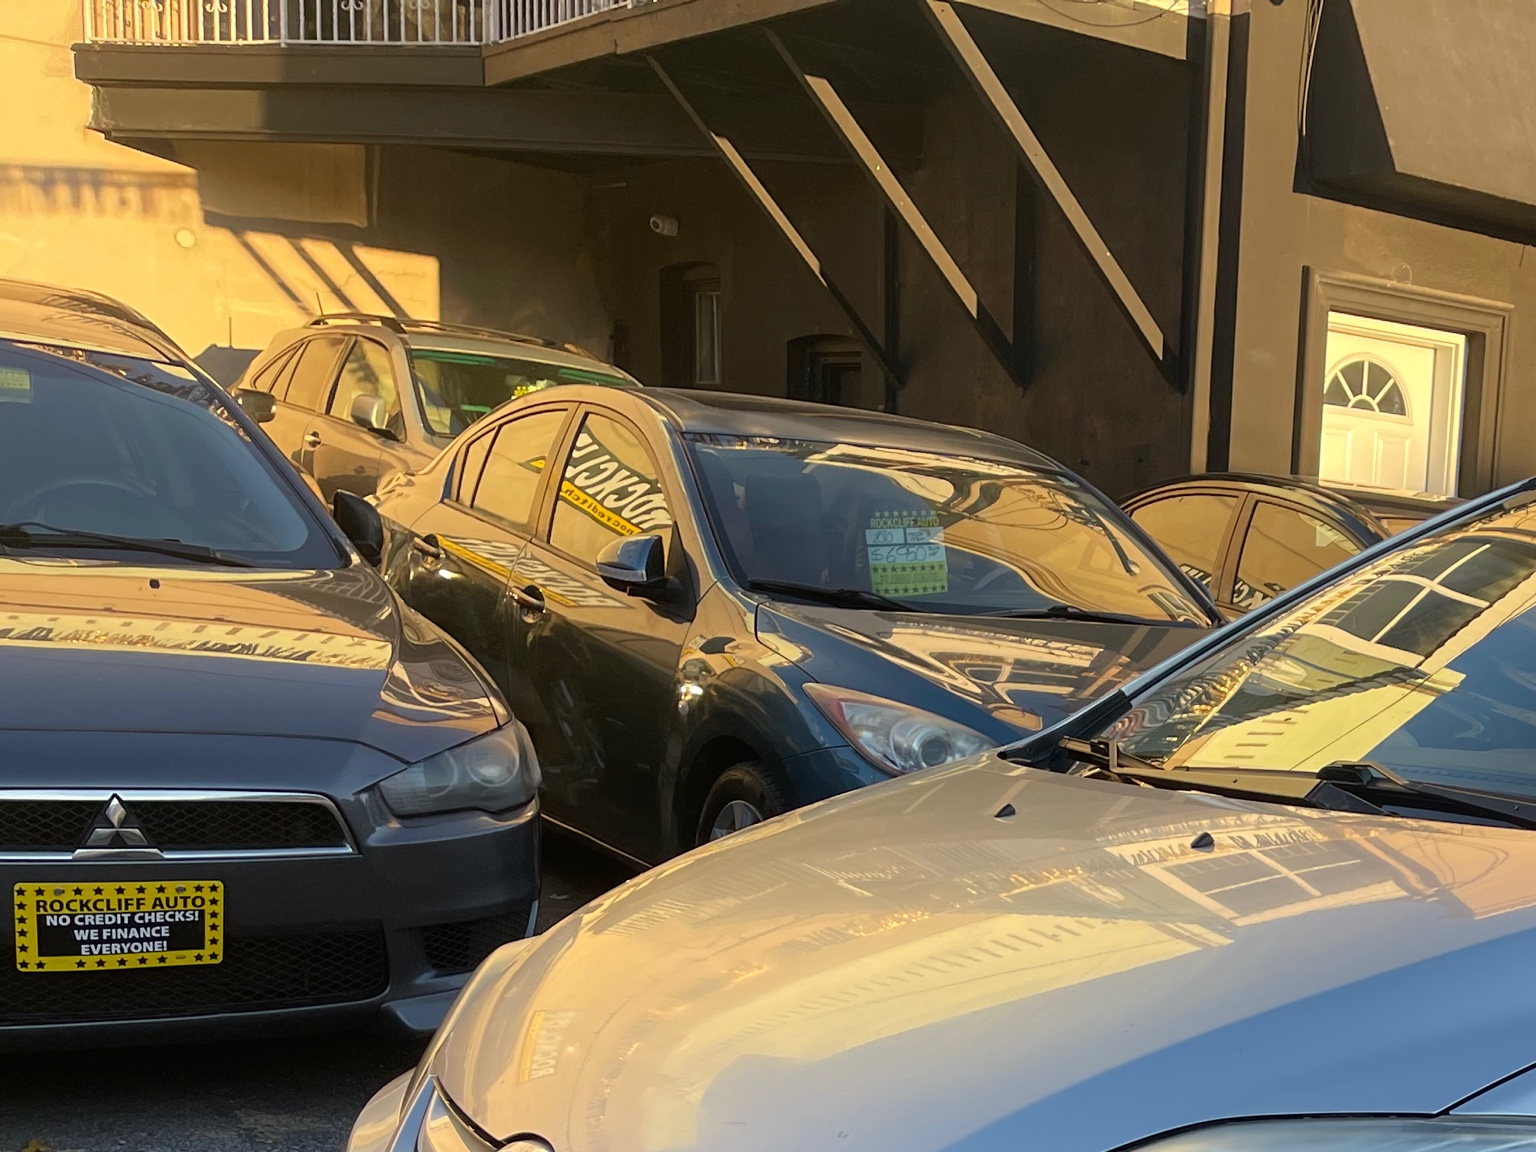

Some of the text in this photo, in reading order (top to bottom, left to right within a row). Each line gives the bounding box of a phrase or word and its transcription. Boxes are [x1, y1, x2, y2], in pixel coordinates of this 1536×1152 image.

[870, 516, 940, 528] ROCKCLIFF AUTO
[36, 896, 206, 913] ROCKCLIFF AUTO
[46, 911, 199, 926] NO CREDIT CHECKS!
[74, 926, 170, 941] WE FINANCE
[81, 941, 168, 956] EVERYONE!
